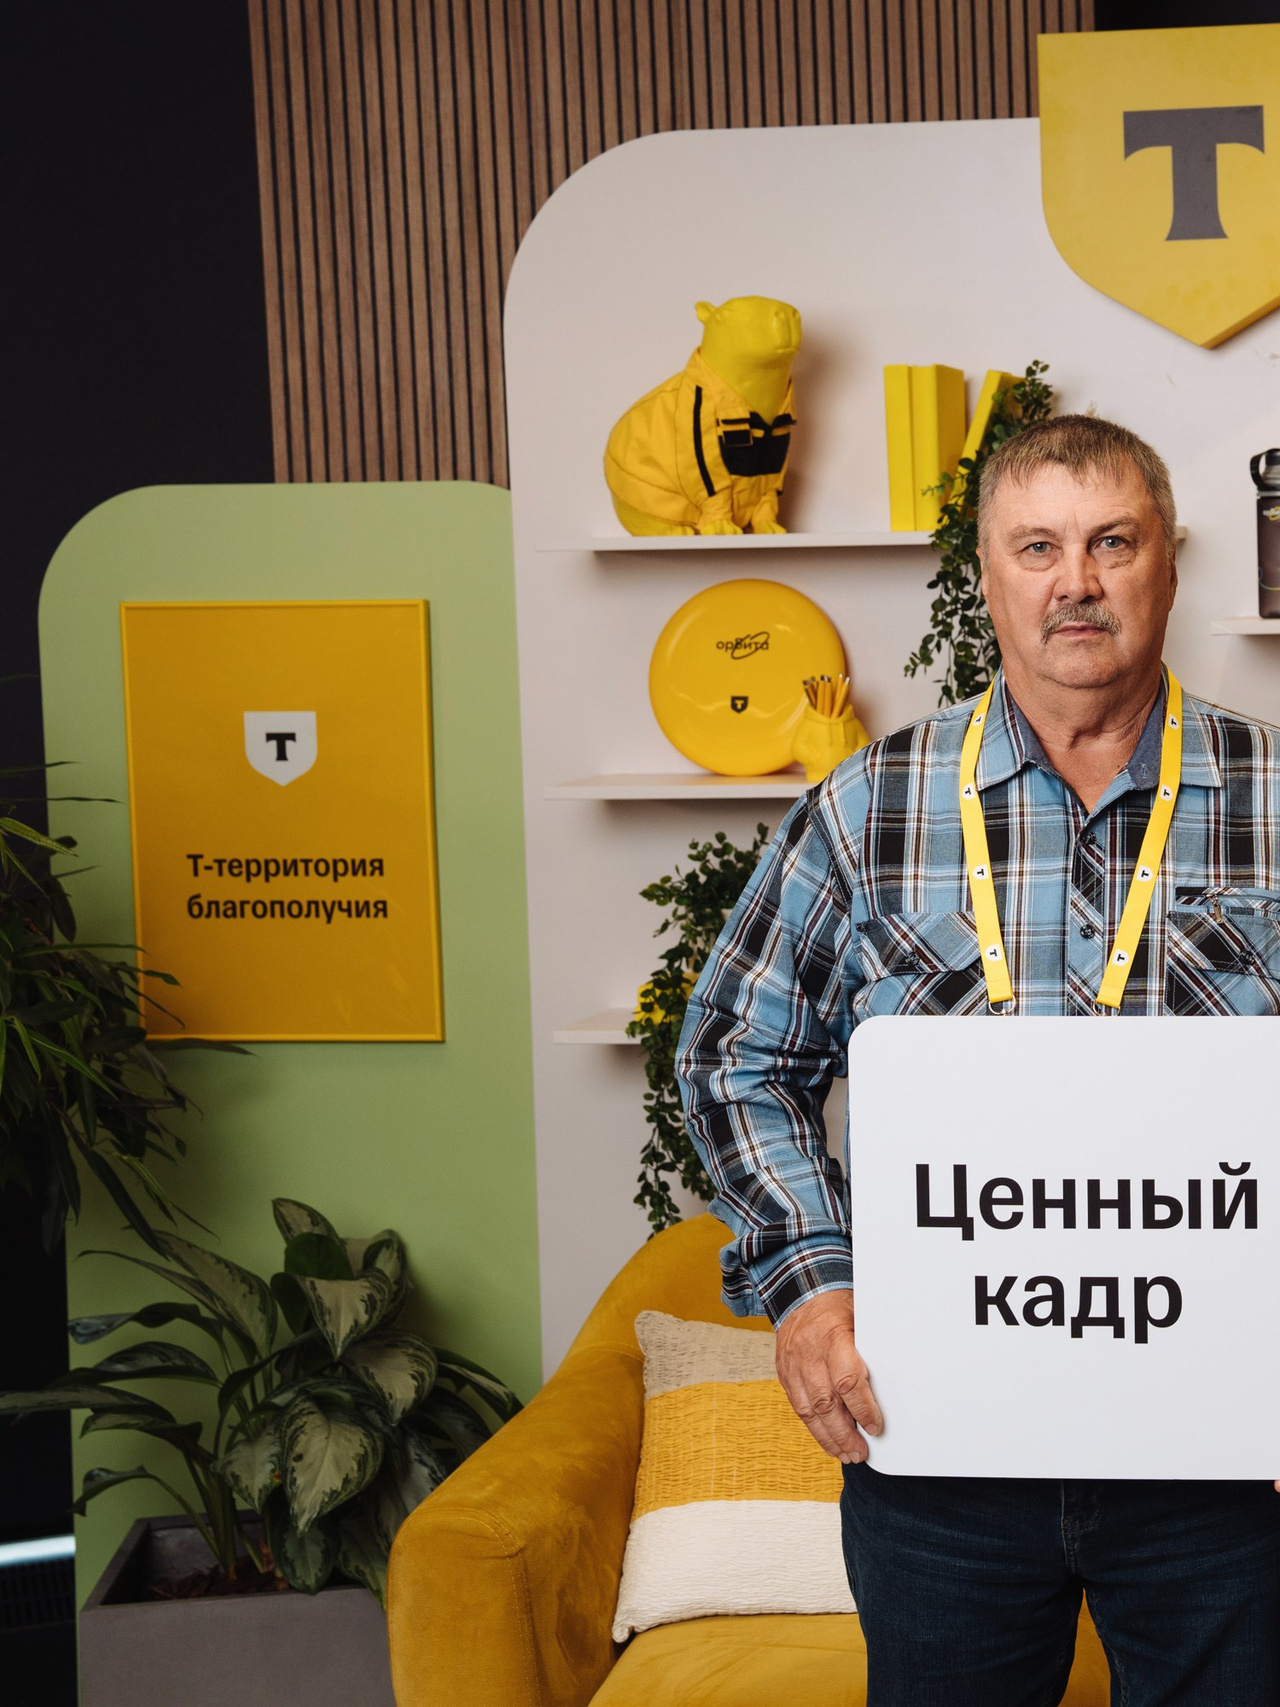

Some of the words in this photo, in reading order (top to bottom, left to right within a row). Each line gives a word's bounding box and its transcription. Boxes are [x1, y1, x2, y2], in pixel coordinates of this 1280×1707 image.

[1123, 105, 1265, 241] Т
[265, 732, 296, 762] Т
[186, 853, 385, 882] Т-территория
[186, 892, 388, 924] благополучия
[915, 1161, 1259, 1242] Ценный
[973, 1275, 1184, 1345] кадр
